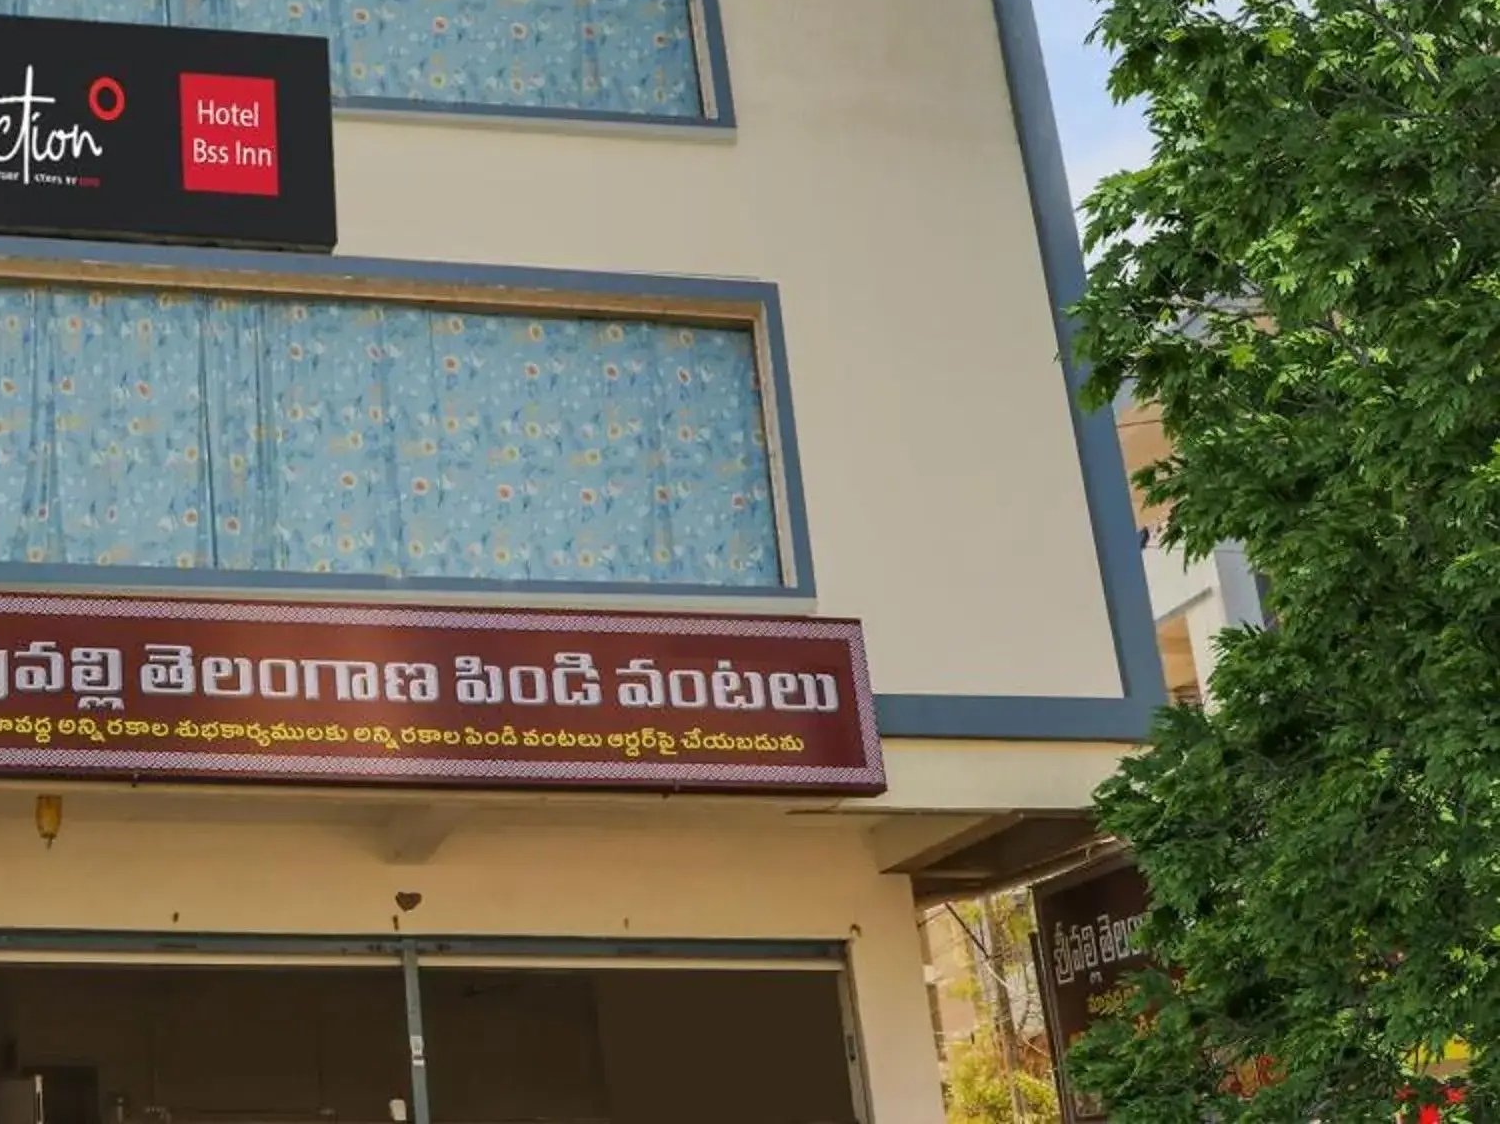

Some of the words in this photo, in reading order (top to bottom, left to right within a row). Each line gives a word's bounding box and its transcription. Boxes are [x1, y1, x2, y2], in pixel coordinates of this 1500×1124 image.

[197, 99, 259, 127] Hotel
[192, 138, 229, 164] Bss
[235, 140, 272, 167] Inn
[139, 642, 440, 704] తెలంగాణ
[455, 651, 601, 707] పిండి
[616, 659, 839, 712] వంటలు
[58, 717, 105, 742] అన్ని
[106, 717, 169, 738] రకాల
[353, 725, 401, 750] అన్ని
[401, 726, 460, 745] రకాల
[464, 726, 519, 746] పిండి
[522, 728, 601, 748] వంటలు
